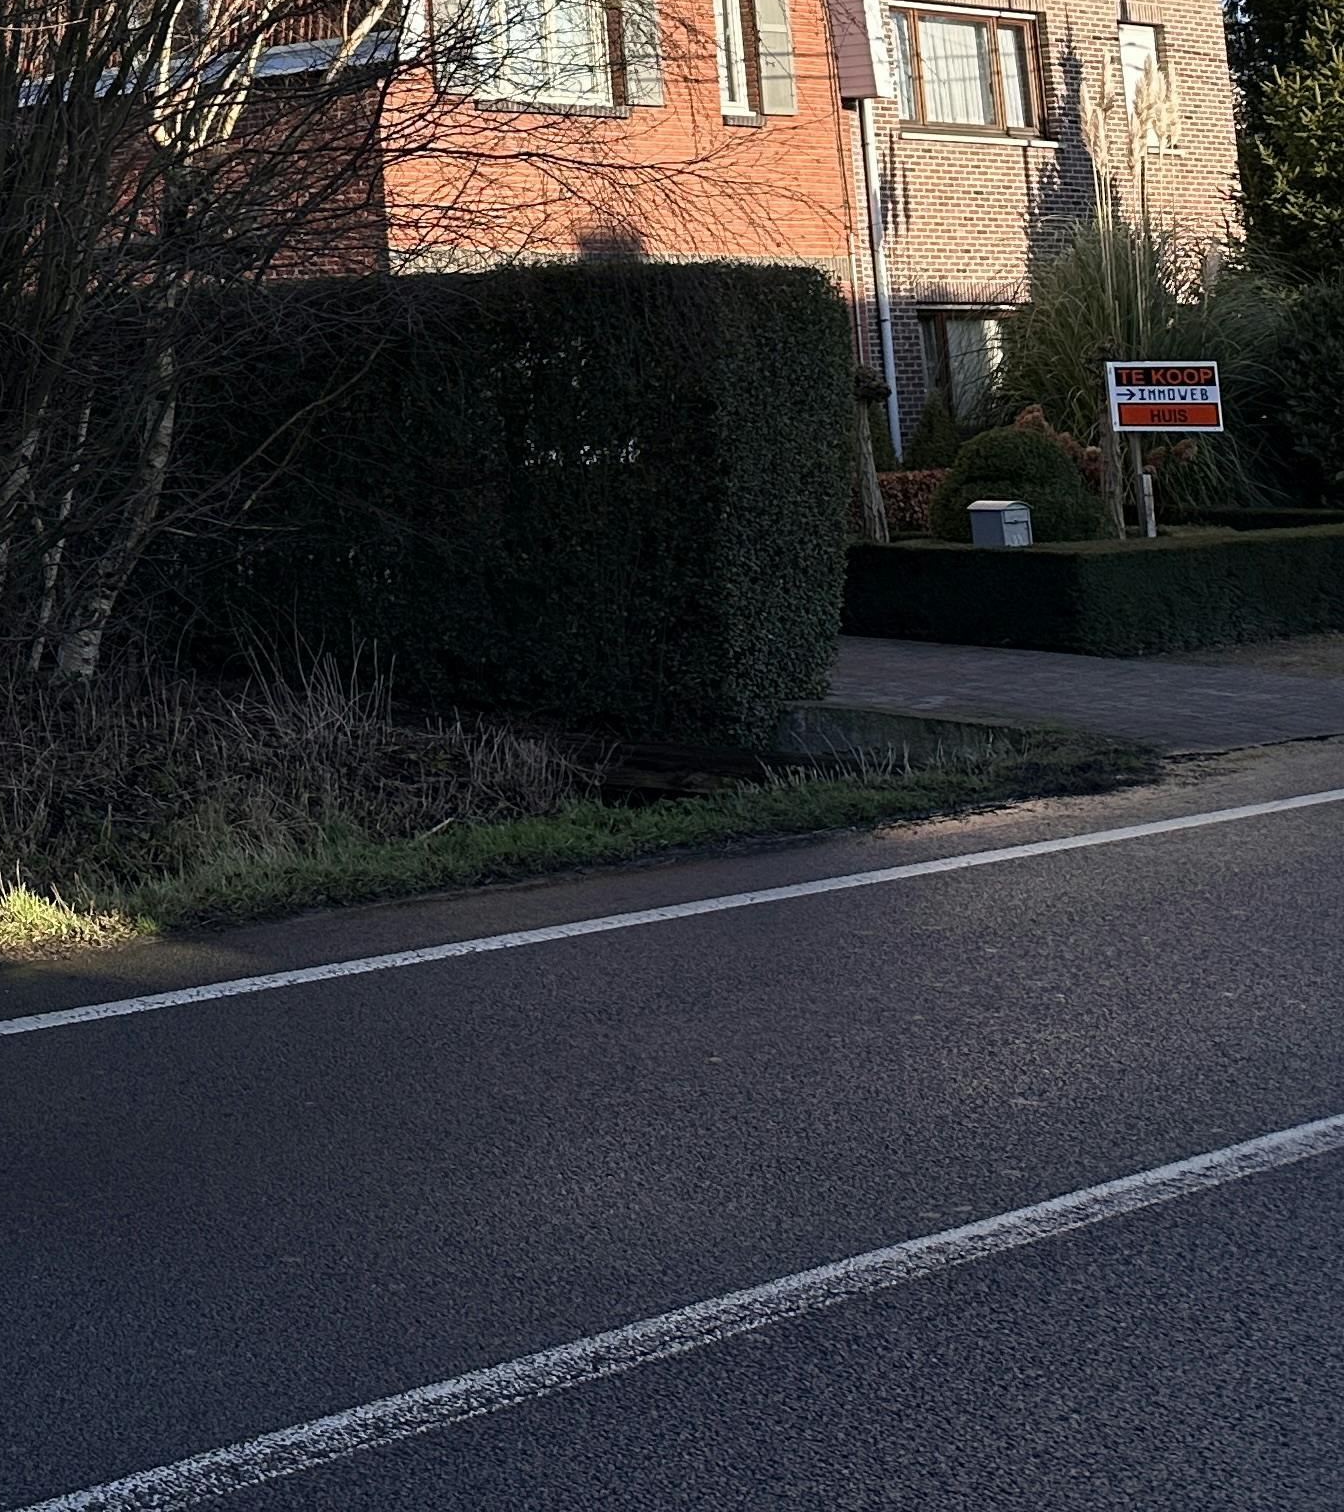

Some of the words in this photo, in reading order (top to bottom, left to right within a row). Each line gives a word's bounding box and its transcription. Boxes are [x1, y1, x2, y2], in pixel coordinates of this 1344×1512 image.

[1117, 369, 1145, 385] TE
[1151, 368, 1213, 385] KOOP
[1138, 388, 1209, 401] IMMOWEB
[1150, 409, 1188, 423] HUIS
